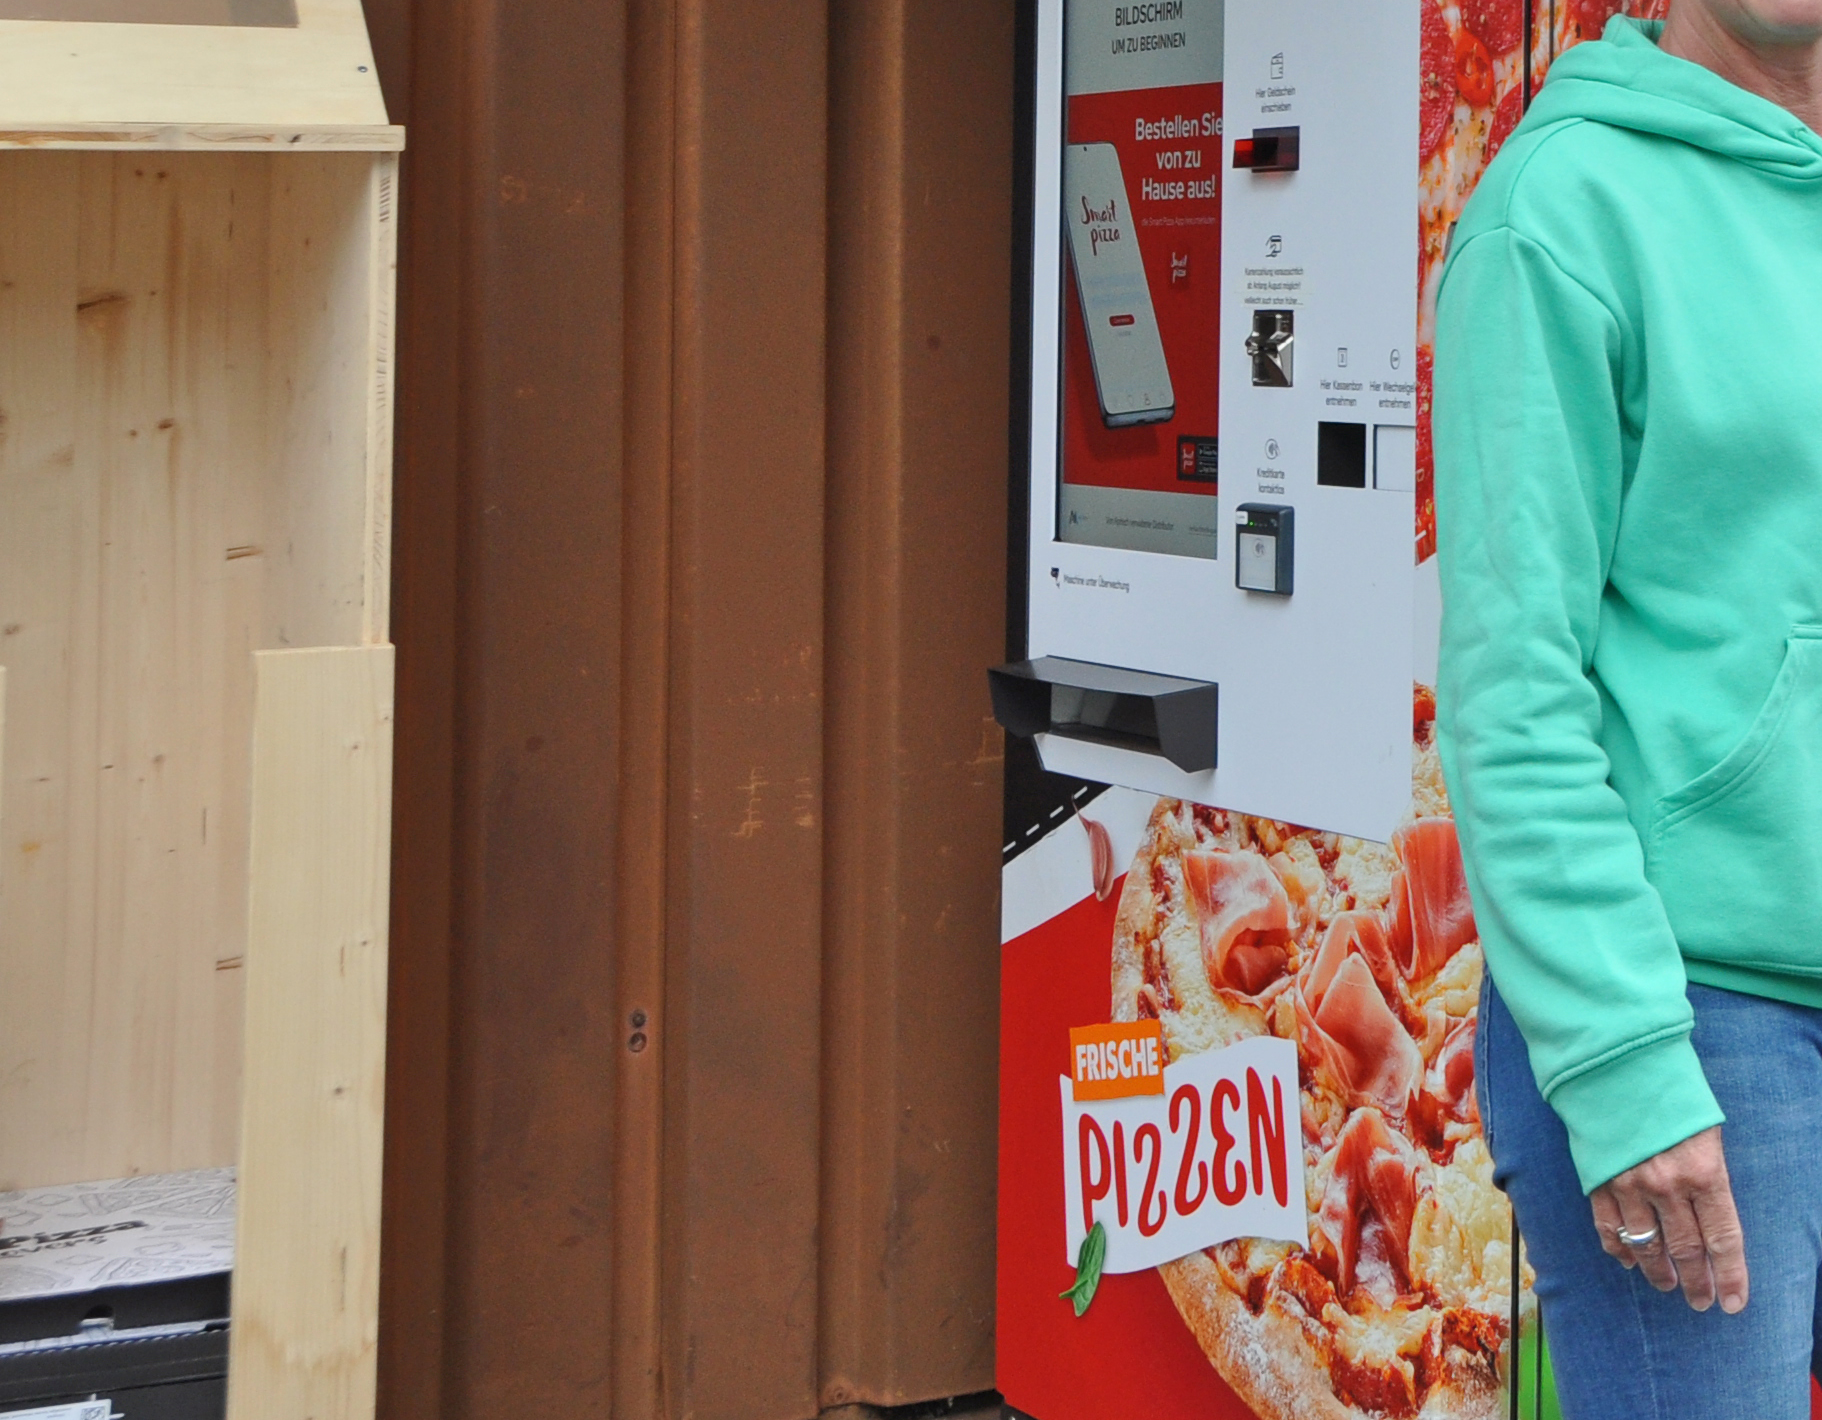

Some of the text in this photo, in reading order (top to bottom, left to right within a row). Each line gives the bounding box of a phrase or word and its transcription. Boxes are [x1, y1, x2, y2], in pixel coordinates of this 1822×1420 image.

[1115, 0, 1183, 27] BILDSCHIRM
[1111, 32, 1186, 55] UM ZU BEGINNEN
[1135, 111, 1223, 141] Bestellen Sie
[1155, 149, 1202, 170] von zu
[1141, 174, 1216, 200] Hause aus!
[1081, 195, 1118, 225] Smart
[1090, 225, 1120, 257] pizza
[1382, 381, 1416, 395] Wechselgel
[1075, 1036, 1160, 1082] FRISCHE
[1078, 1065, 1288, 1238] PIZZEN
